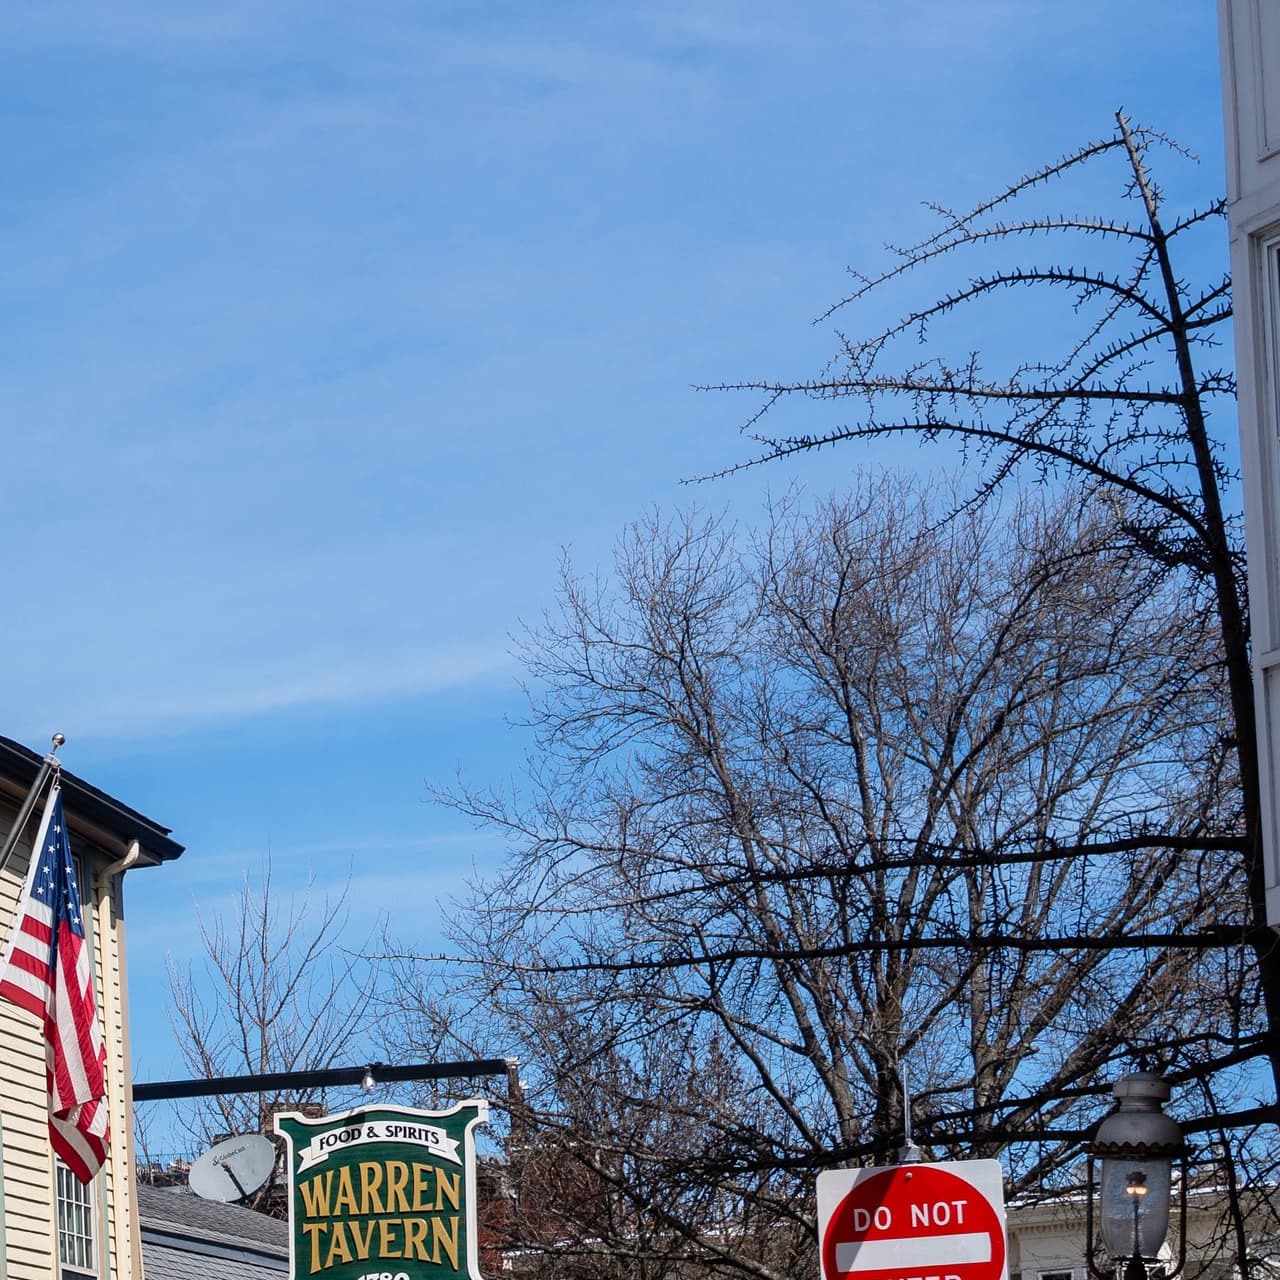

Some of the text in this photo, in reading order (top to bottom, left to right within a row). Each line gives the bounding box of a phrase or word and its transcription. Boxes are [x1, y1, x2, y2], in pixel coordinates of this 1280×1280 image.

[319, 1125, 439, 1150] FOOD & SPIRITS
[298, 1160, 461, 1218] WARREN
[854, 1200, 967, 1232] DO NOT
[302, 1216, 460, 1275] TAVERN
